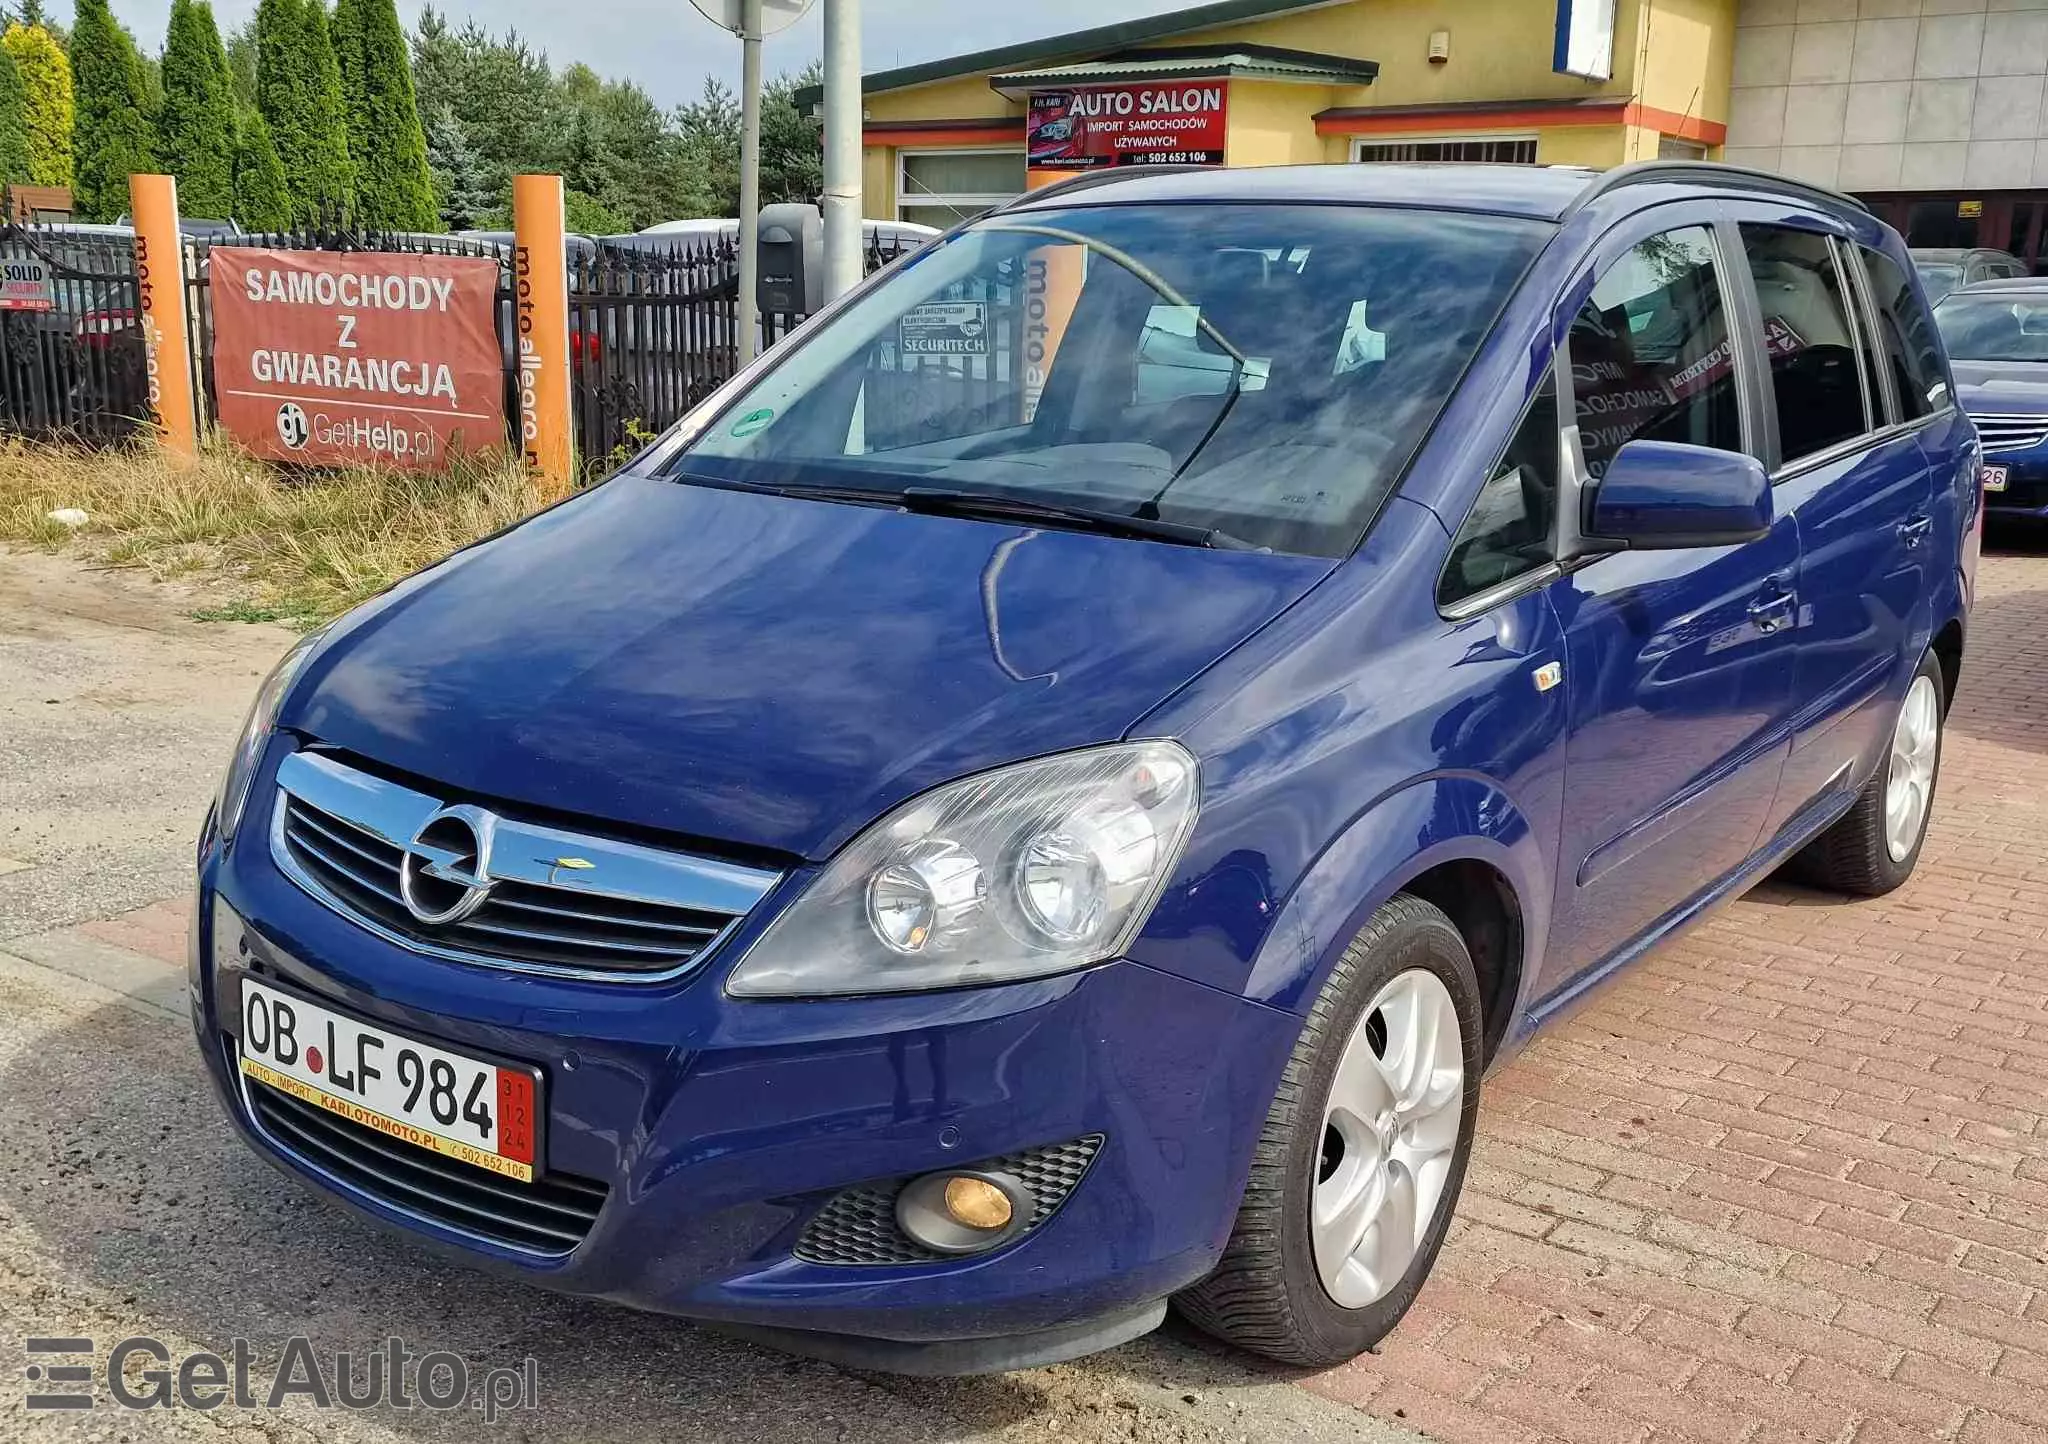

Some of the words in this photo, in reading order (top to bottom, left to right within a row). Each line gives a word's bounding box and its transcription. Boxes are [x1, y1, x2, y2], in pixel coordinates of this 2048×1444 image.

[1069, 92, 1135, 117] AUTO
[1139, 87, 1221, 114] SALON
[1087, 119, 1123, 132] IMPORT
[1128, 115, 1207, 131] SAMOCHODÓW
[1114, 134, 1177, 148] UŻYWANYCH
[1133, 154, 1147, 163] tel:
[1149, 152, 1167, 163] 502
[1169, 151, 1186, 162] 652
[1189, 151, 1206, 162] 106
[4, 265, 42, 281] SOLID
[246, 268, 454, 312] SAMOCHODY
[337, 314, 357, 348] Z
[904, 338, 985, 352] SECURITECH
[251, 349, 458, 409] GWARANCJĄ
[313, 412, 435, 464] GetHelp.pl
[246, 991, 299, 1066] OB
[327, 1020, 384, 1096] LF
[397, 1048, 493, 1139] 984
[246, 1063, 271, 1081] AUTO
[277, 1076, 311, 1099] IMPORT
[320, 1094, 441, 1151] KARI.OTOMOTO.PL
[462, 1148, 480, 1163] 502
[483, 1154, 502, 1172] 652
[507, 1161, 525, 1178] 106
[504, 1127, 525, 1149] 24
